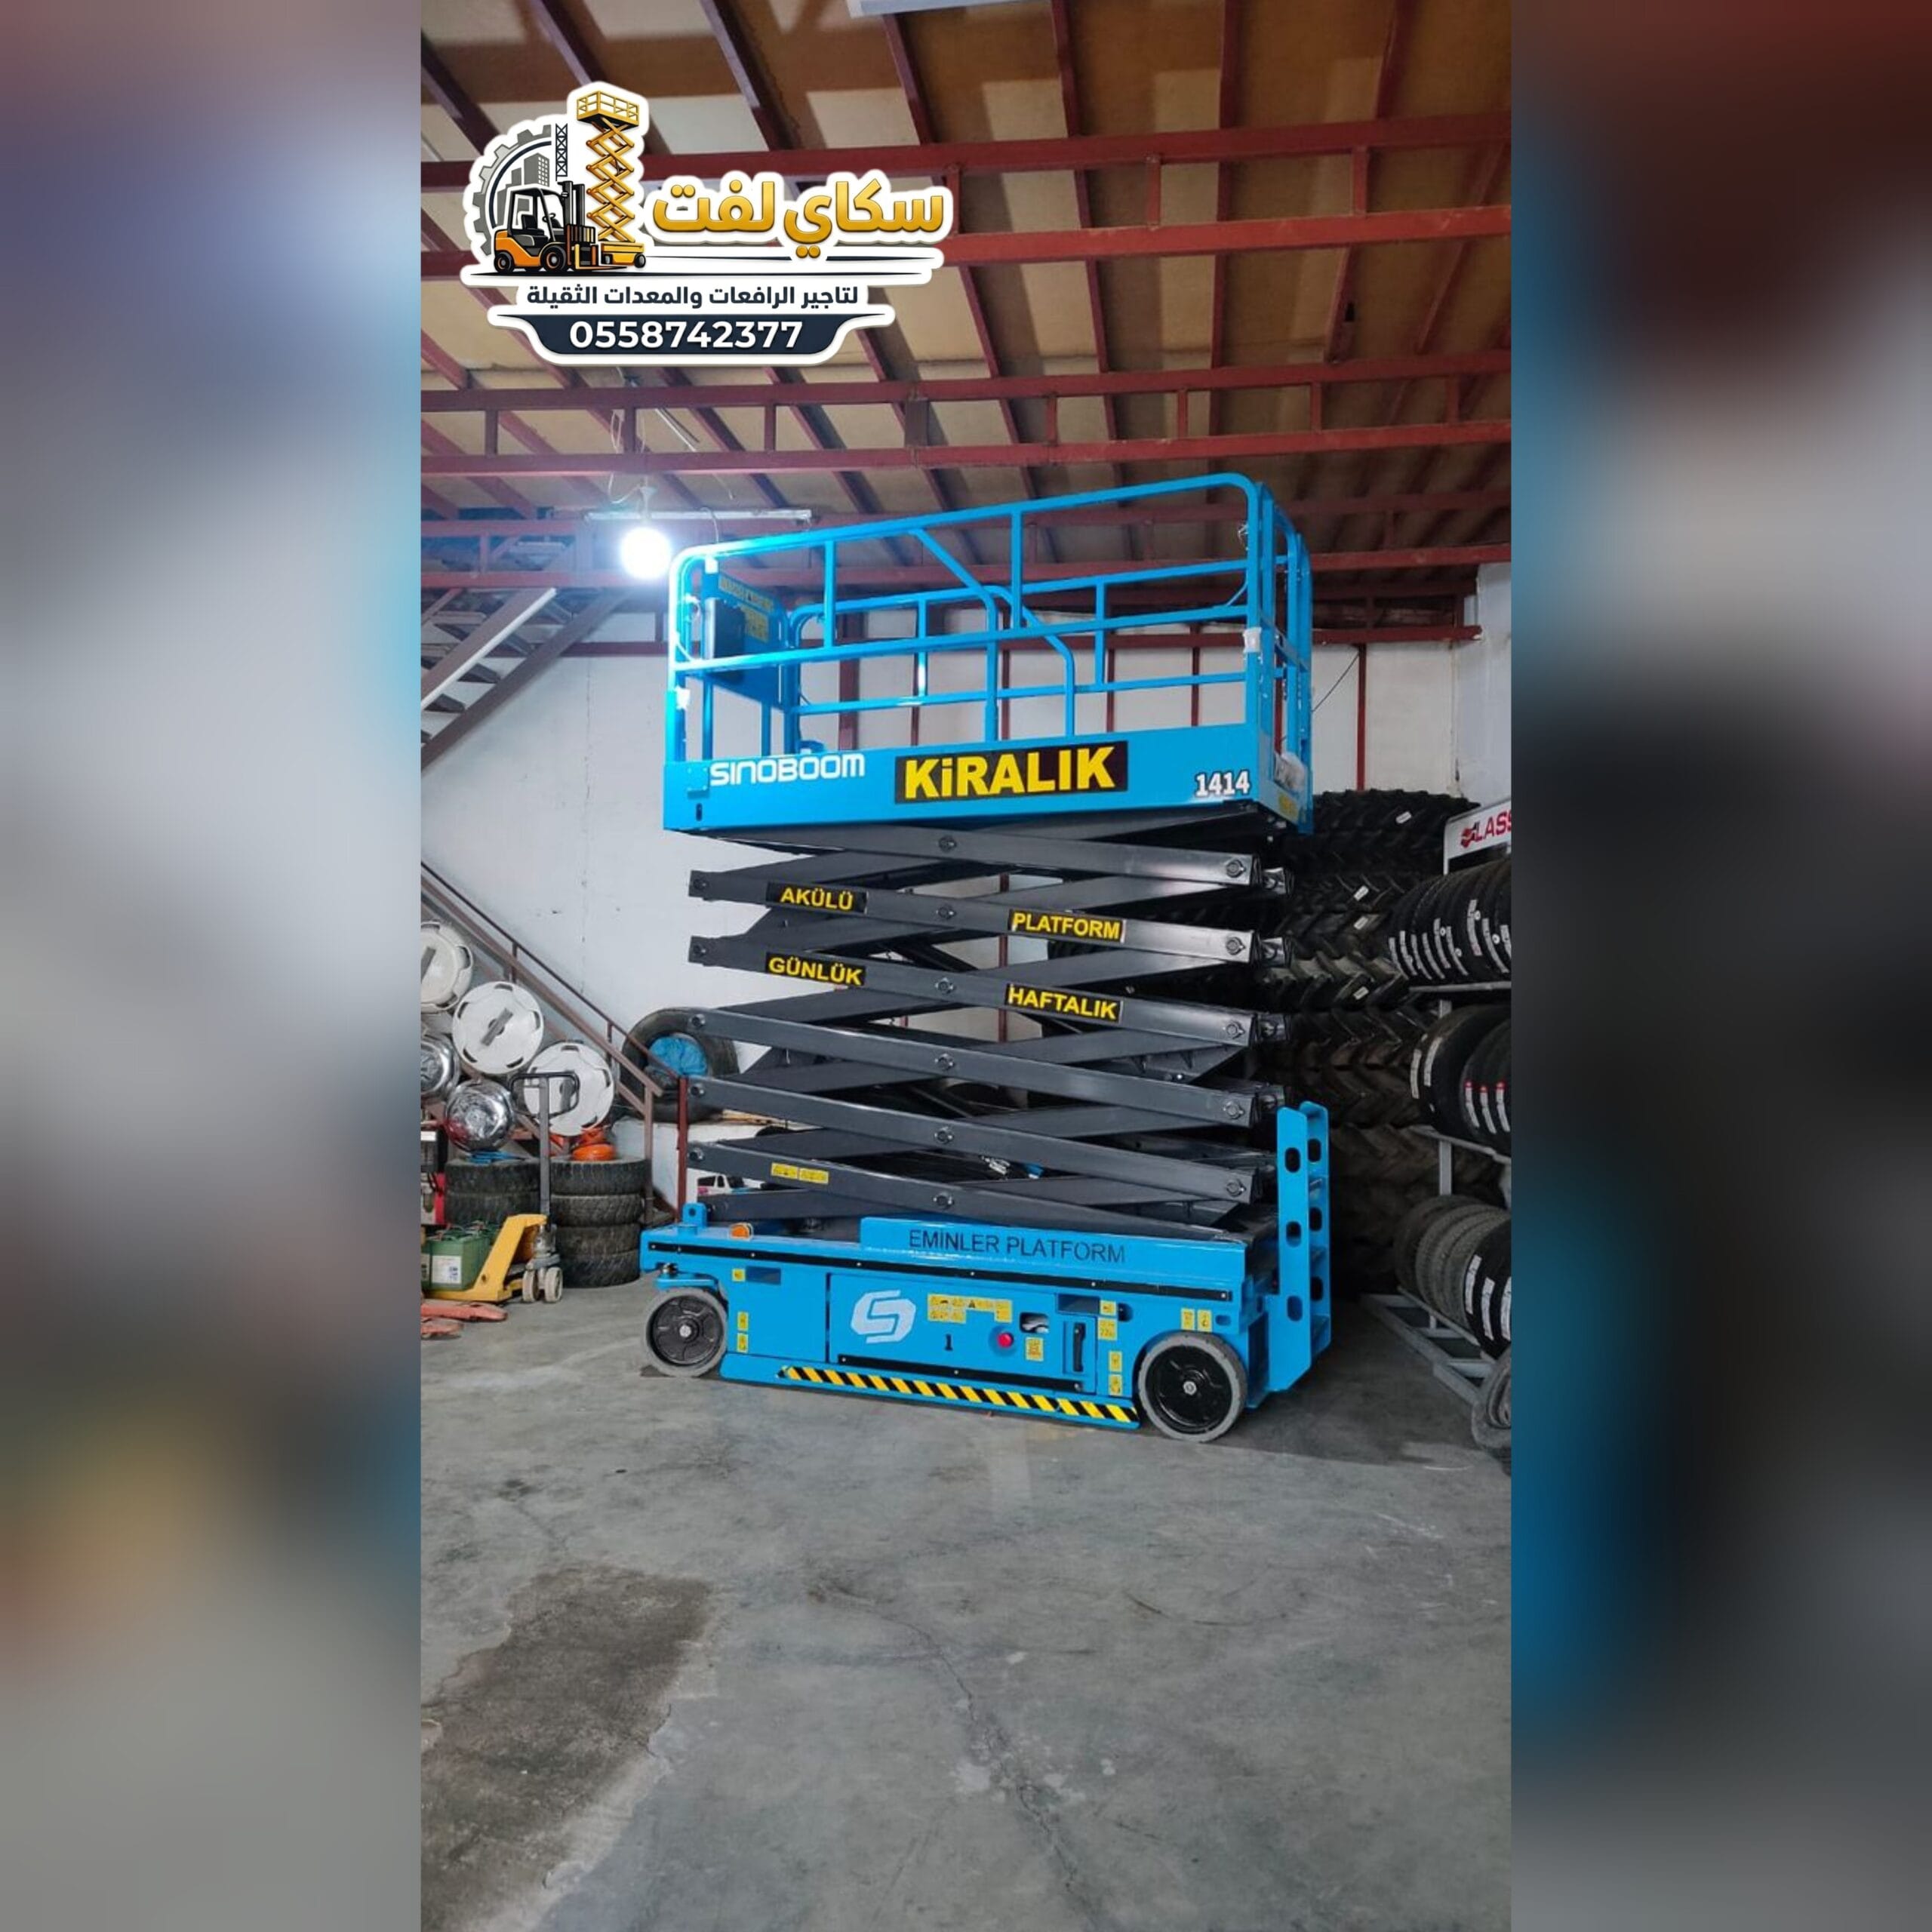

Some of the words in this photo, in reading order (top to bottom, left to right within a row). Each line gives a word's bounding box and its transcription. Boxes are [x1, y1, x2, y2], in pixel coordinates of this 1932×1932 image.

[1195, 770, 1251, 797] 1414
[780, 886, 854, 910] AKÜLÜ
[1012, 912, 1121, 940] PLATFORM
[768, 956, 863, 986] GÜNLÜK
[1008, 986, 1117, 1019] HAFTALIK
[1006, 1235, 1125, 1263] PLATFORM
